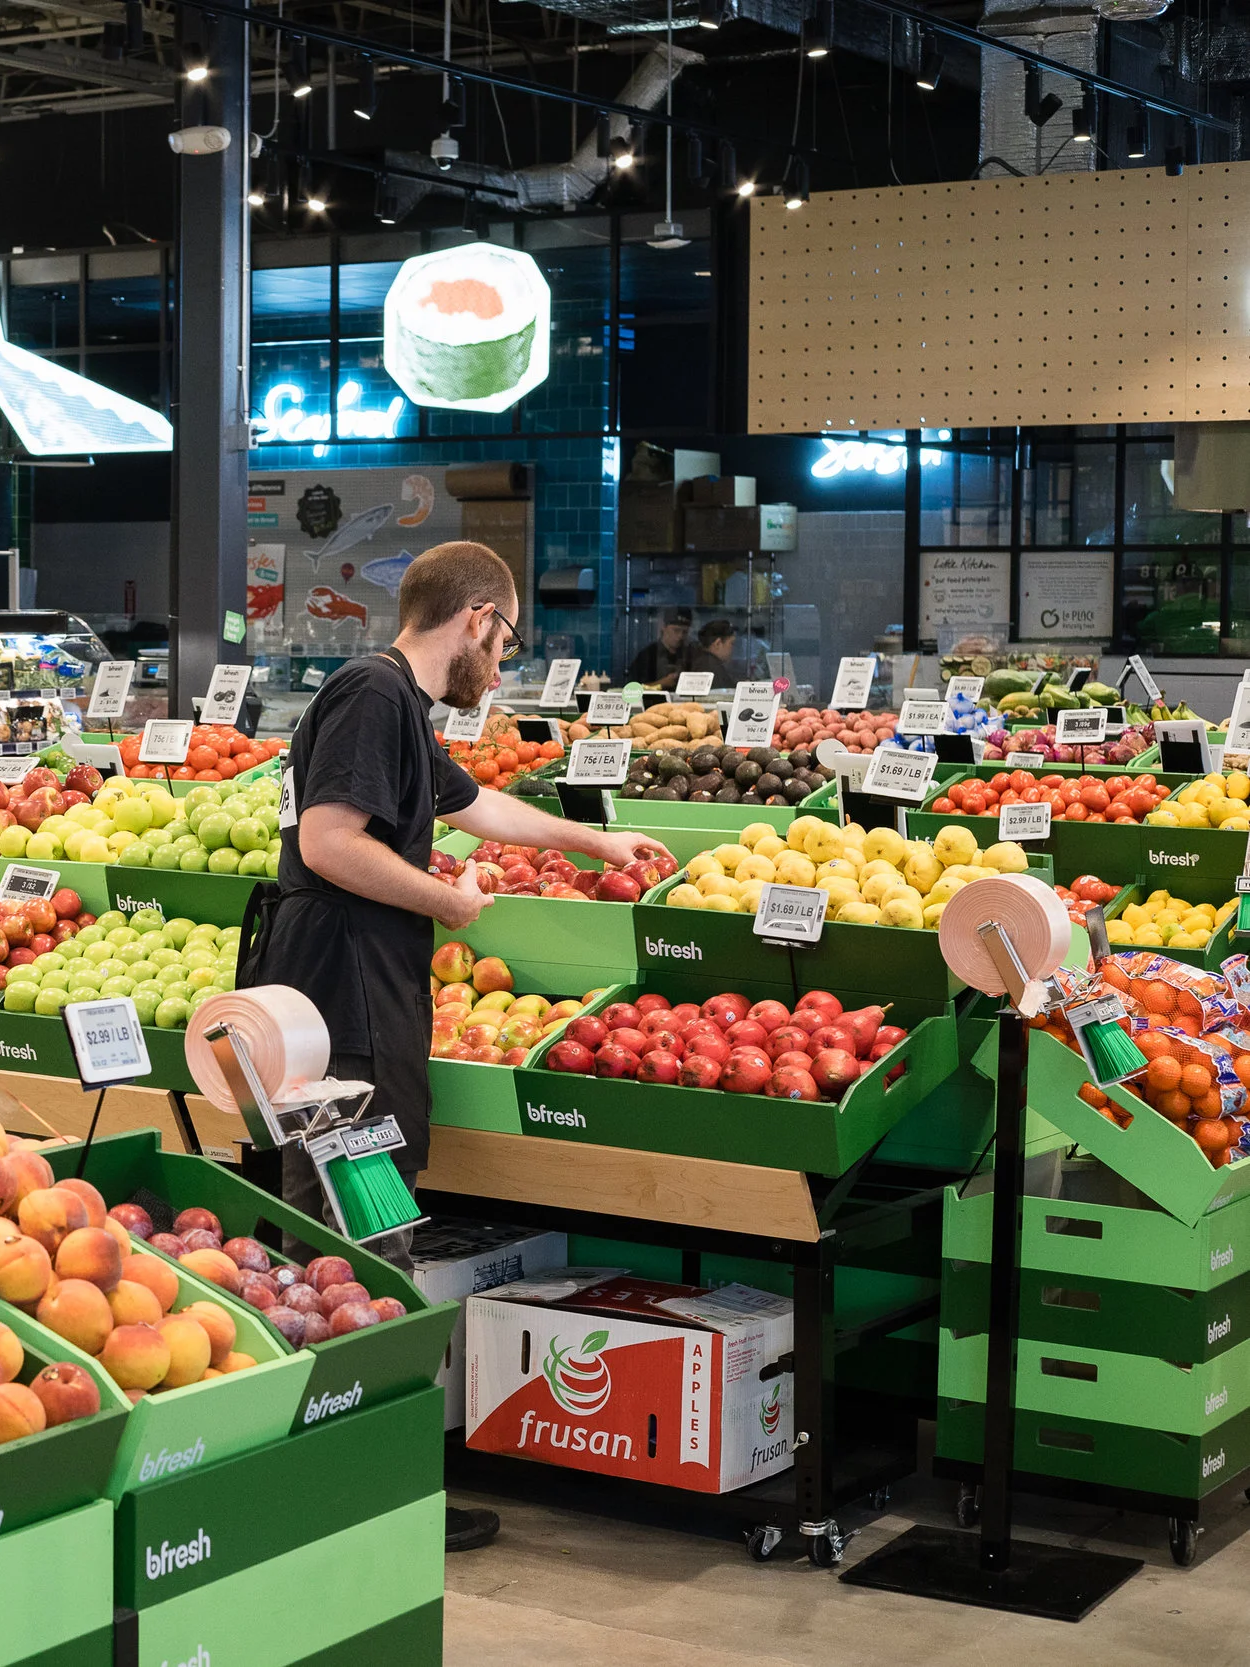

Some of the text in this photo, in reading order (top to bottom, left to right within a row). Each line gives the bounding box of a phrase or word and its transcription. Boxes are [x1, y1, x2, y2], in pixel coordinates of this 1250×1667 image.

[908, 712, 925, 720] $1.99
[583, 755, 597, 765] 75¢
[603, 755, 615, 764] EA
[880, 764, 903, 776] $1.69
[909, 768, 922, 778] LB
[1009, 816, 1027, 825] $2.99
[1032, 815, 1042, 823] LB
[770, 902, 794, 915] $1.69
[800, 906, 814, 917] LB
[645, 936, 703, 961] bfresh
[86, 1028, 110, 1045] $2.99
[116, 1026, 130, 1041] LB
[527, 1102, 587, 1128] bfresh
[350, 1129, 393, 1148] TWIST EASE
[1210, 1244, 1234, 1271] bfresh
[1207, 1314, 1232, 1344] bfresh
[303, 1383, 363, 1425] bfresh
[692, 1343, 703, 1450] APPLES
[1205, 1385, 1228, 1416] bfresh
[517, 1409, 633, 1460] frusan
[138, 1437, 205, 1483] bfresh
[750, 1438, 787, 1473] frusan
[1202, 1448, 1226, 1478] bfresh
[145, 1529, 211, 1580] bfresh
